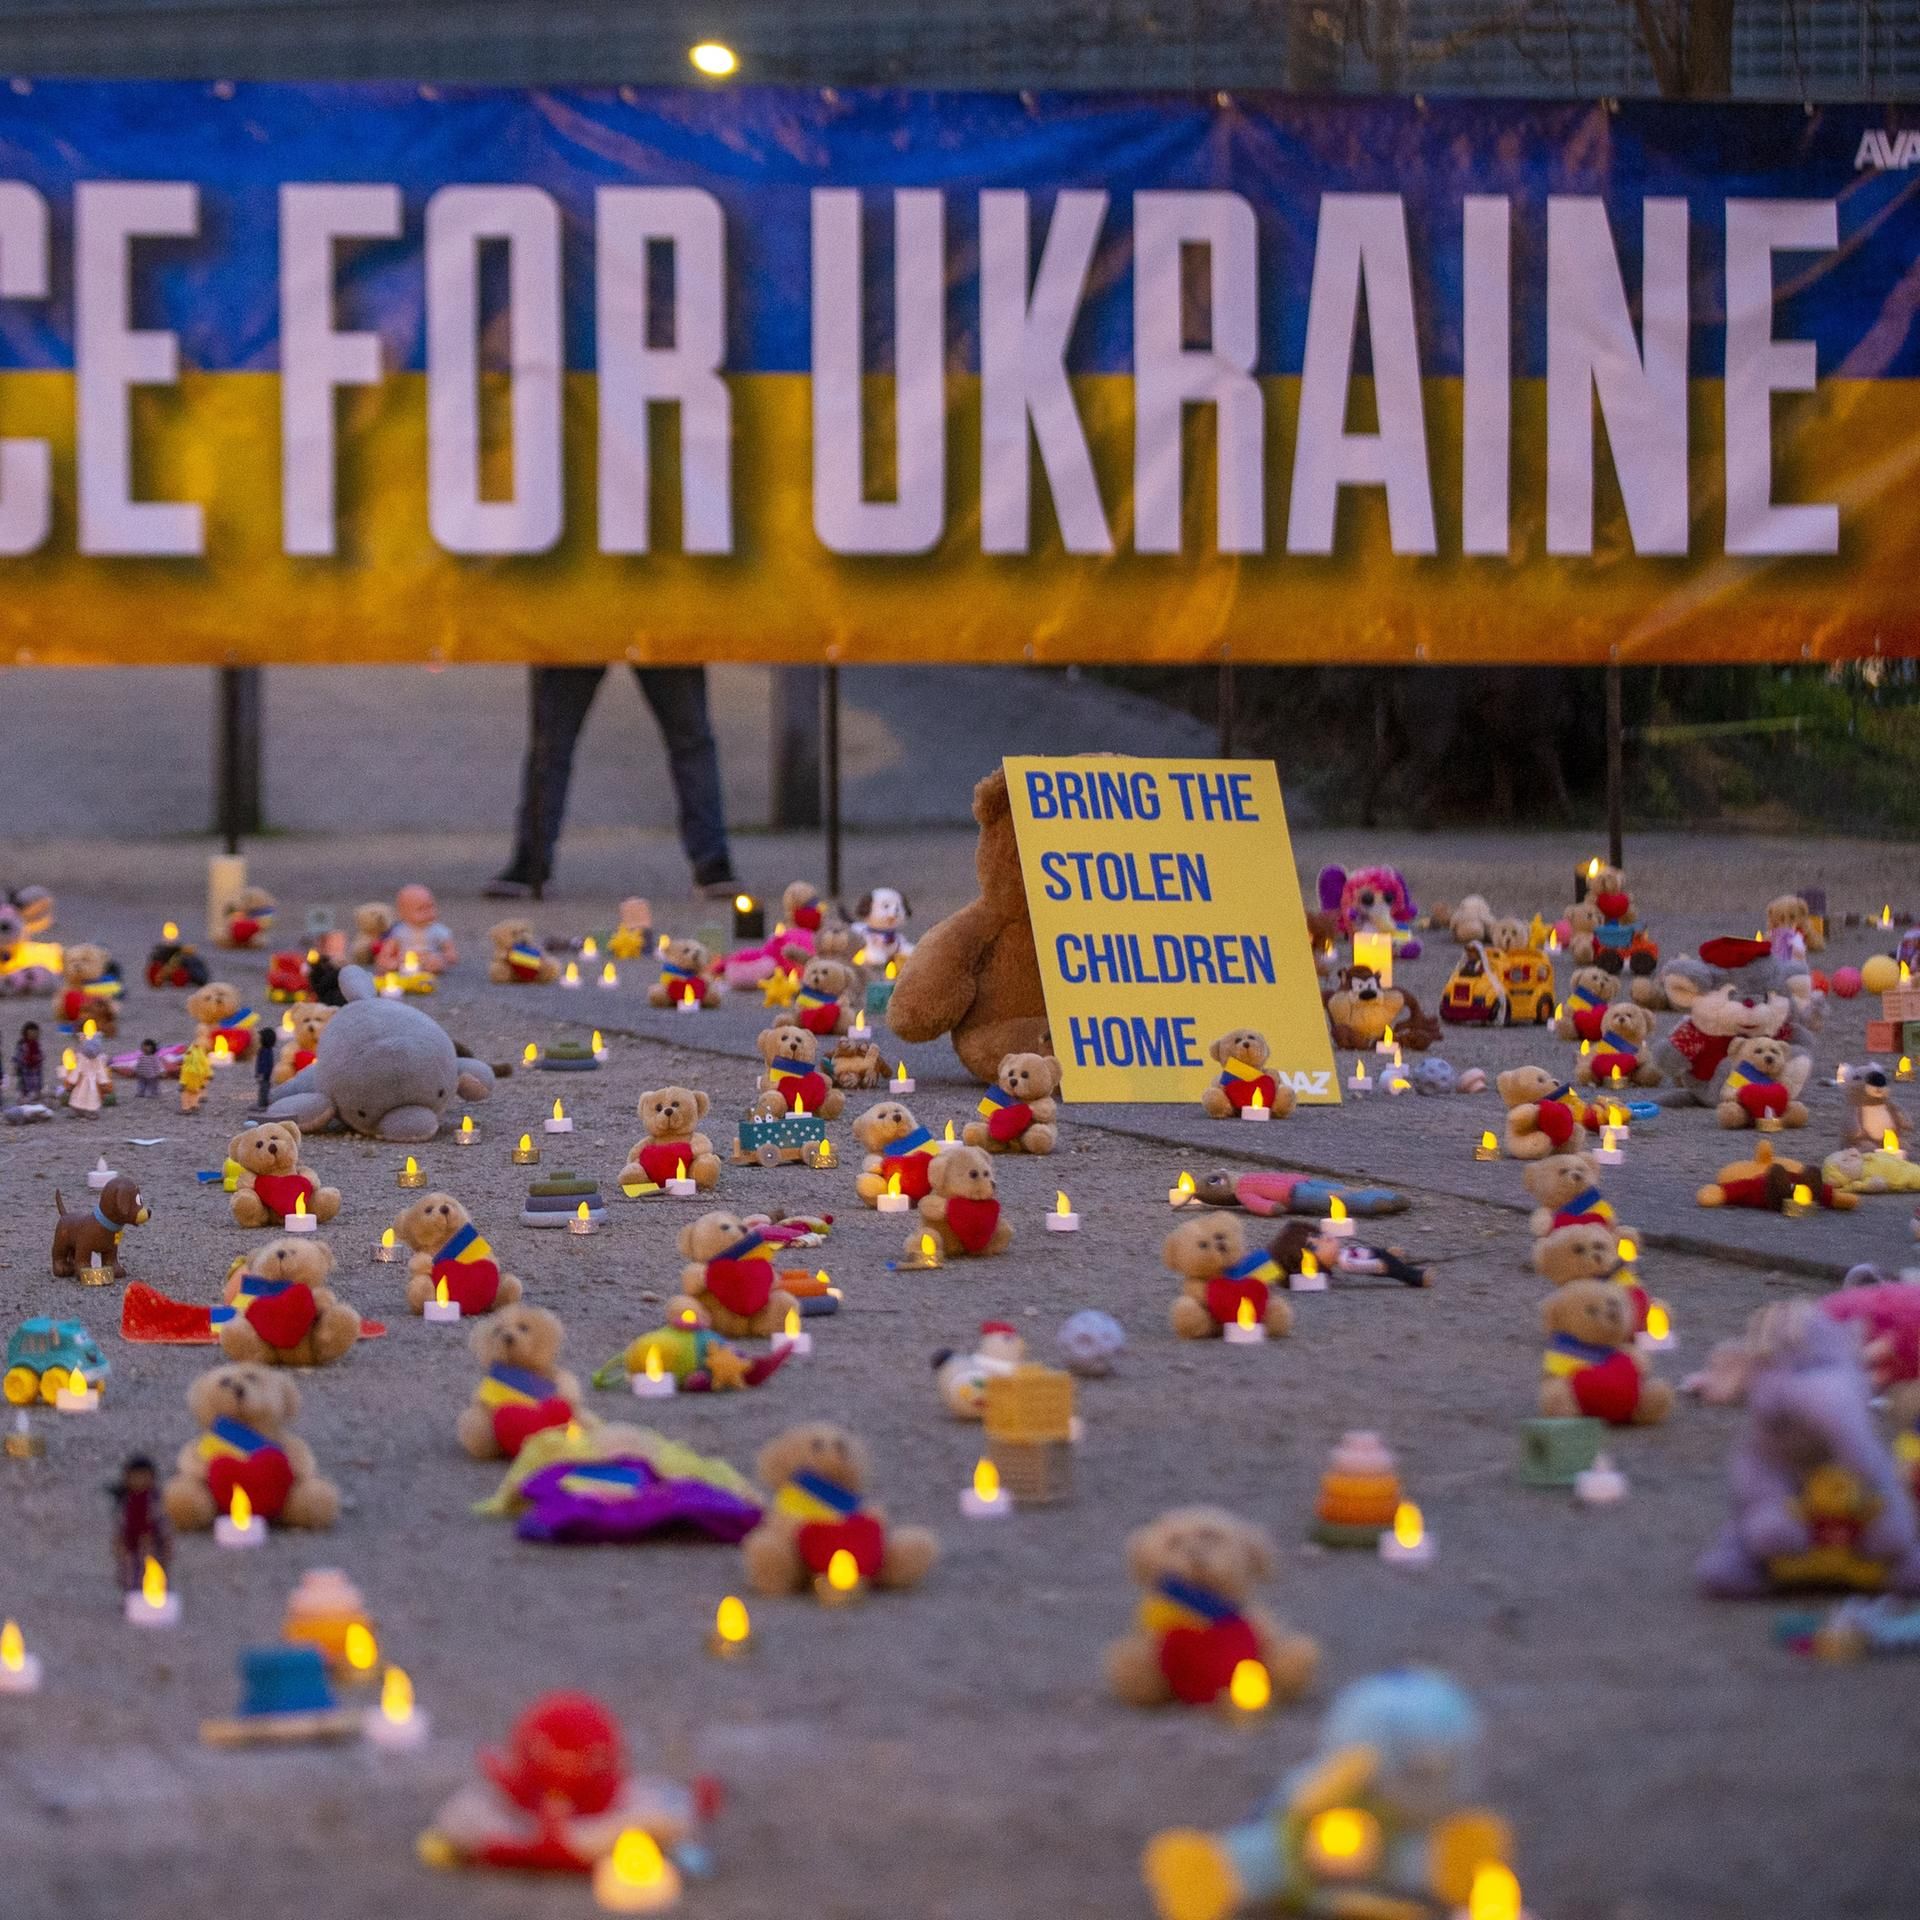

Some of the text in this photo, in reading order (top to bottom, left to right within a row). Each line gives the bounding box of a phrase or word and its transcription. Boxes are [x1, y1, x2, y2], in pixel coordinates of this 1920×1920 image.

[278, 182, 734, 556] FOR
[810, 188, 1840, 557] UKRAINE
[1025, 771, 1260, 822] BRING THE
[1040, 852, 1212, 902] STOLEN
[1055, 933, 1277, 984] CHILDREN
[1069, 1016, 1204, 1067] HOME
